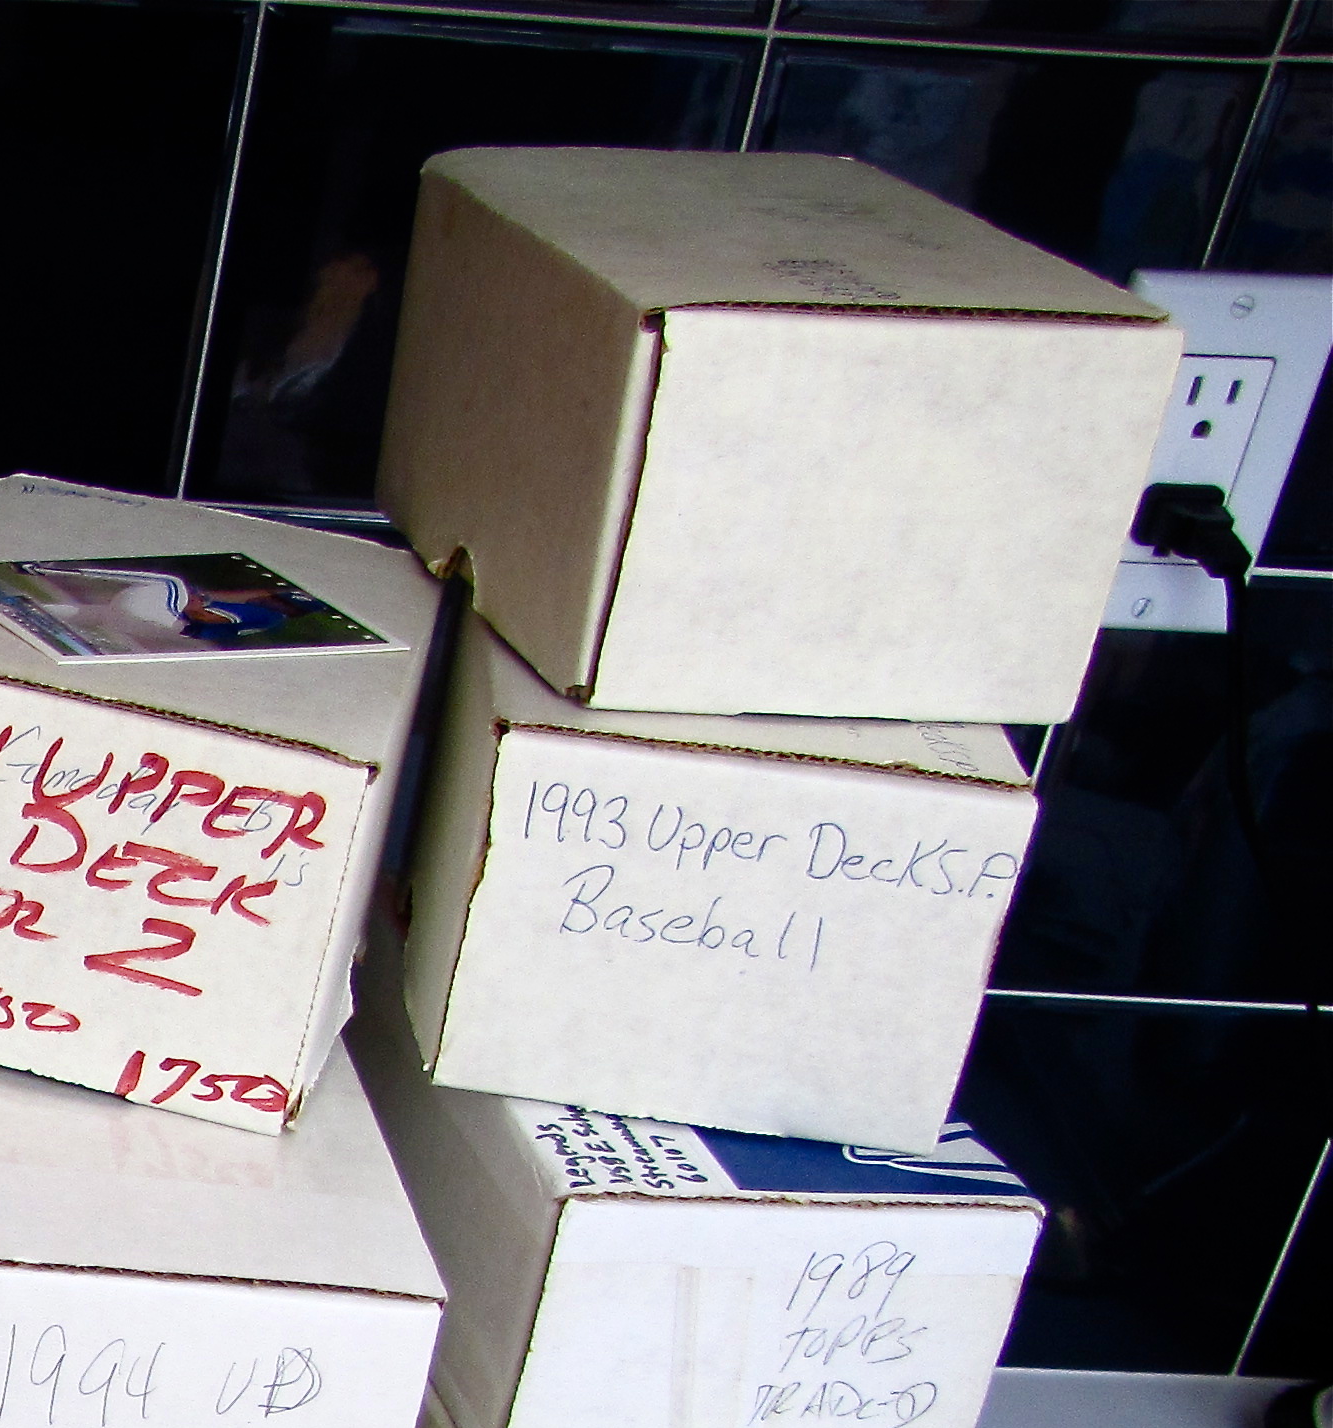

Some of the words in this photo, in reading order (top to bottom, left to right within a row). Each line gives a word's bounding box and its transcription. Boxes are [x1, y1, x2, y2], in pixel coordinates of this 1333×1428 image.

[32, 737, 327, 859] UPPER
[524, 781, 629, 851] 1993
[647, 805, 788, 871] Upper
[9, 802, 277, 927] DECK
[83, 918, 203, 997] 2
[559, 863, 823, 972] Baseball
[786, 1240, 918, 1317] 1989
